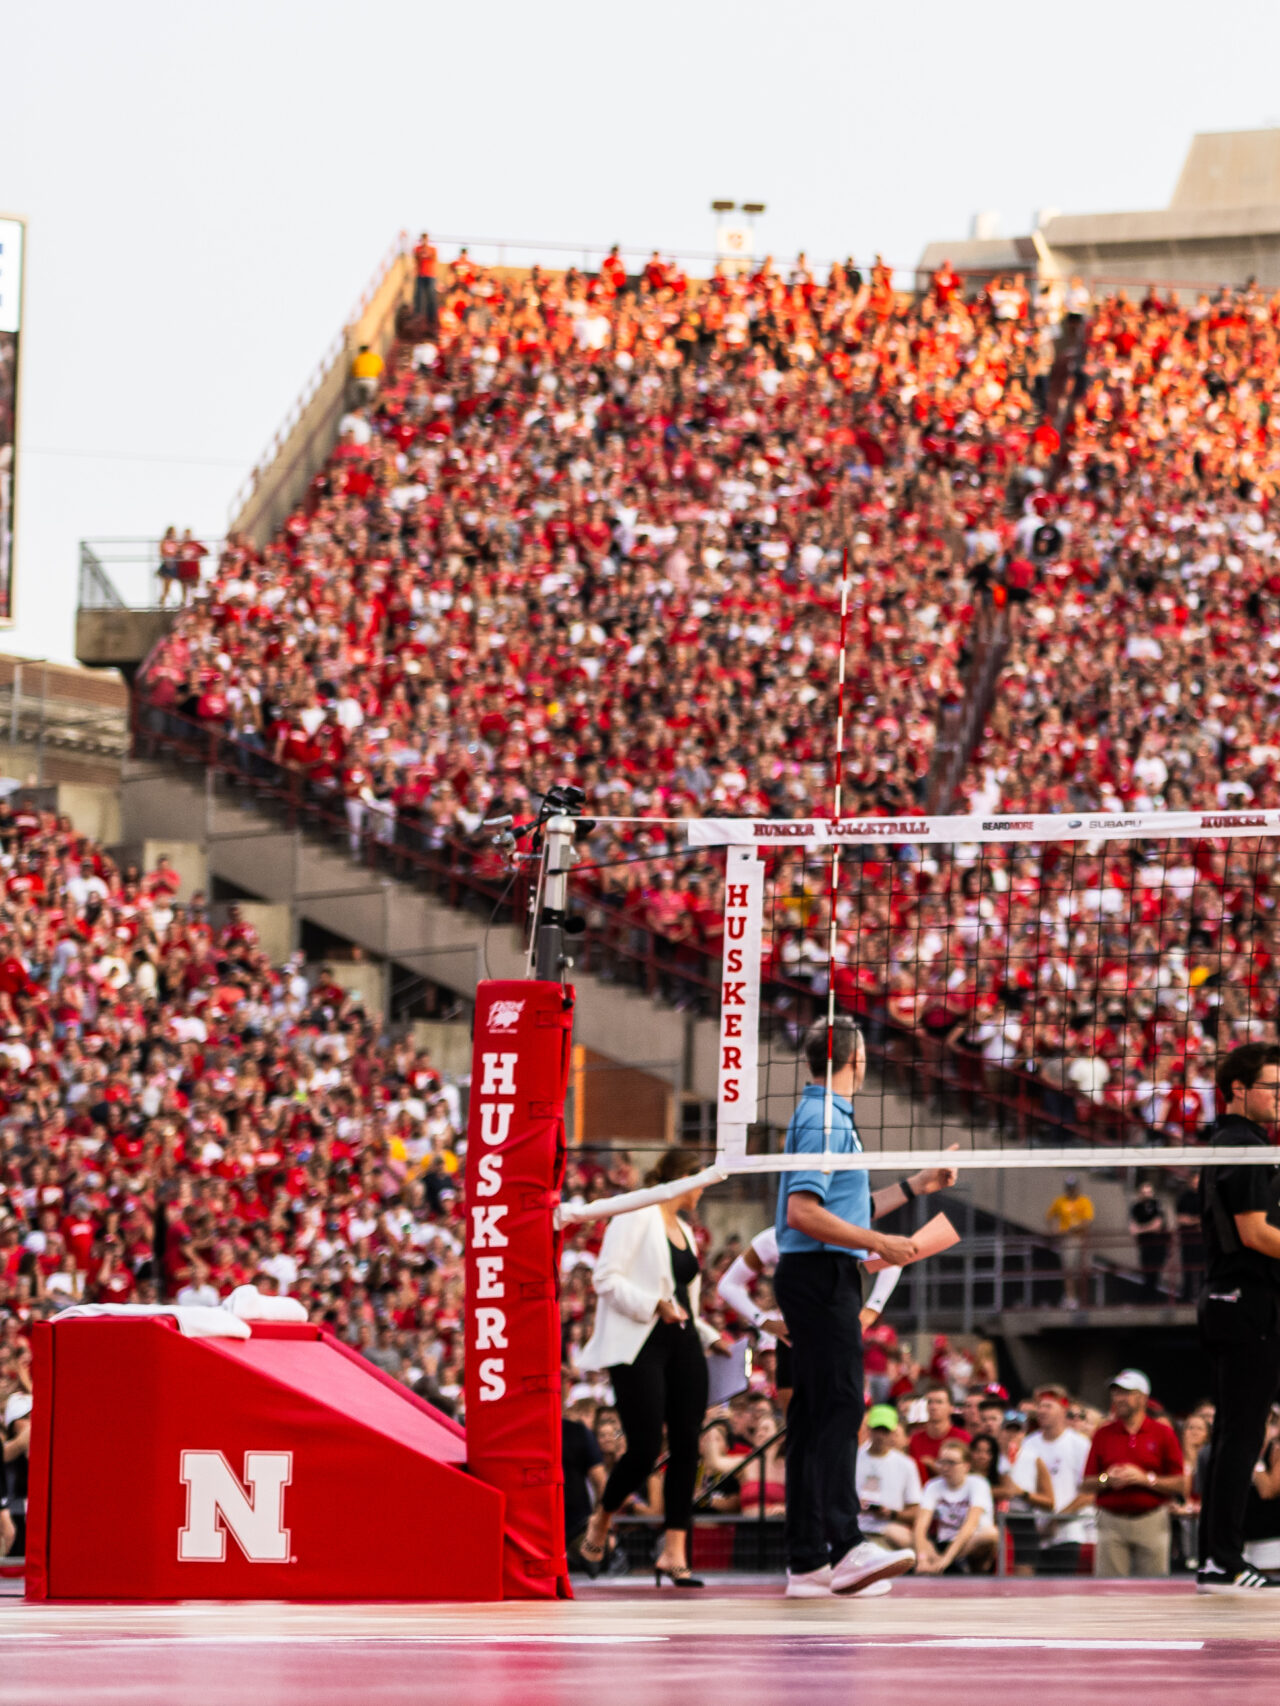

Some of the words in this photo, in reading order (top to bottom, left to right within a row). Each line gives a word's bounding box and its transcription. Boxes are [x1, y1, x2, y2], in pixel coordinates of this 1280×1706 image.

[753, 823, 815, 836] HUSKER
[825, 821, 930, 836] VOLLEYBALL
[982, 820, 1035, 831] BEARDMORE
[1088, 819, 1142, 829] SUBARU
[1200, 814, 1267, 829] HUSKER
[722, 884, 749, 1103] HUSKERS
[471, 1052, 519, 1402] HUSKERS
[177, 1449, 293, 1564] N
